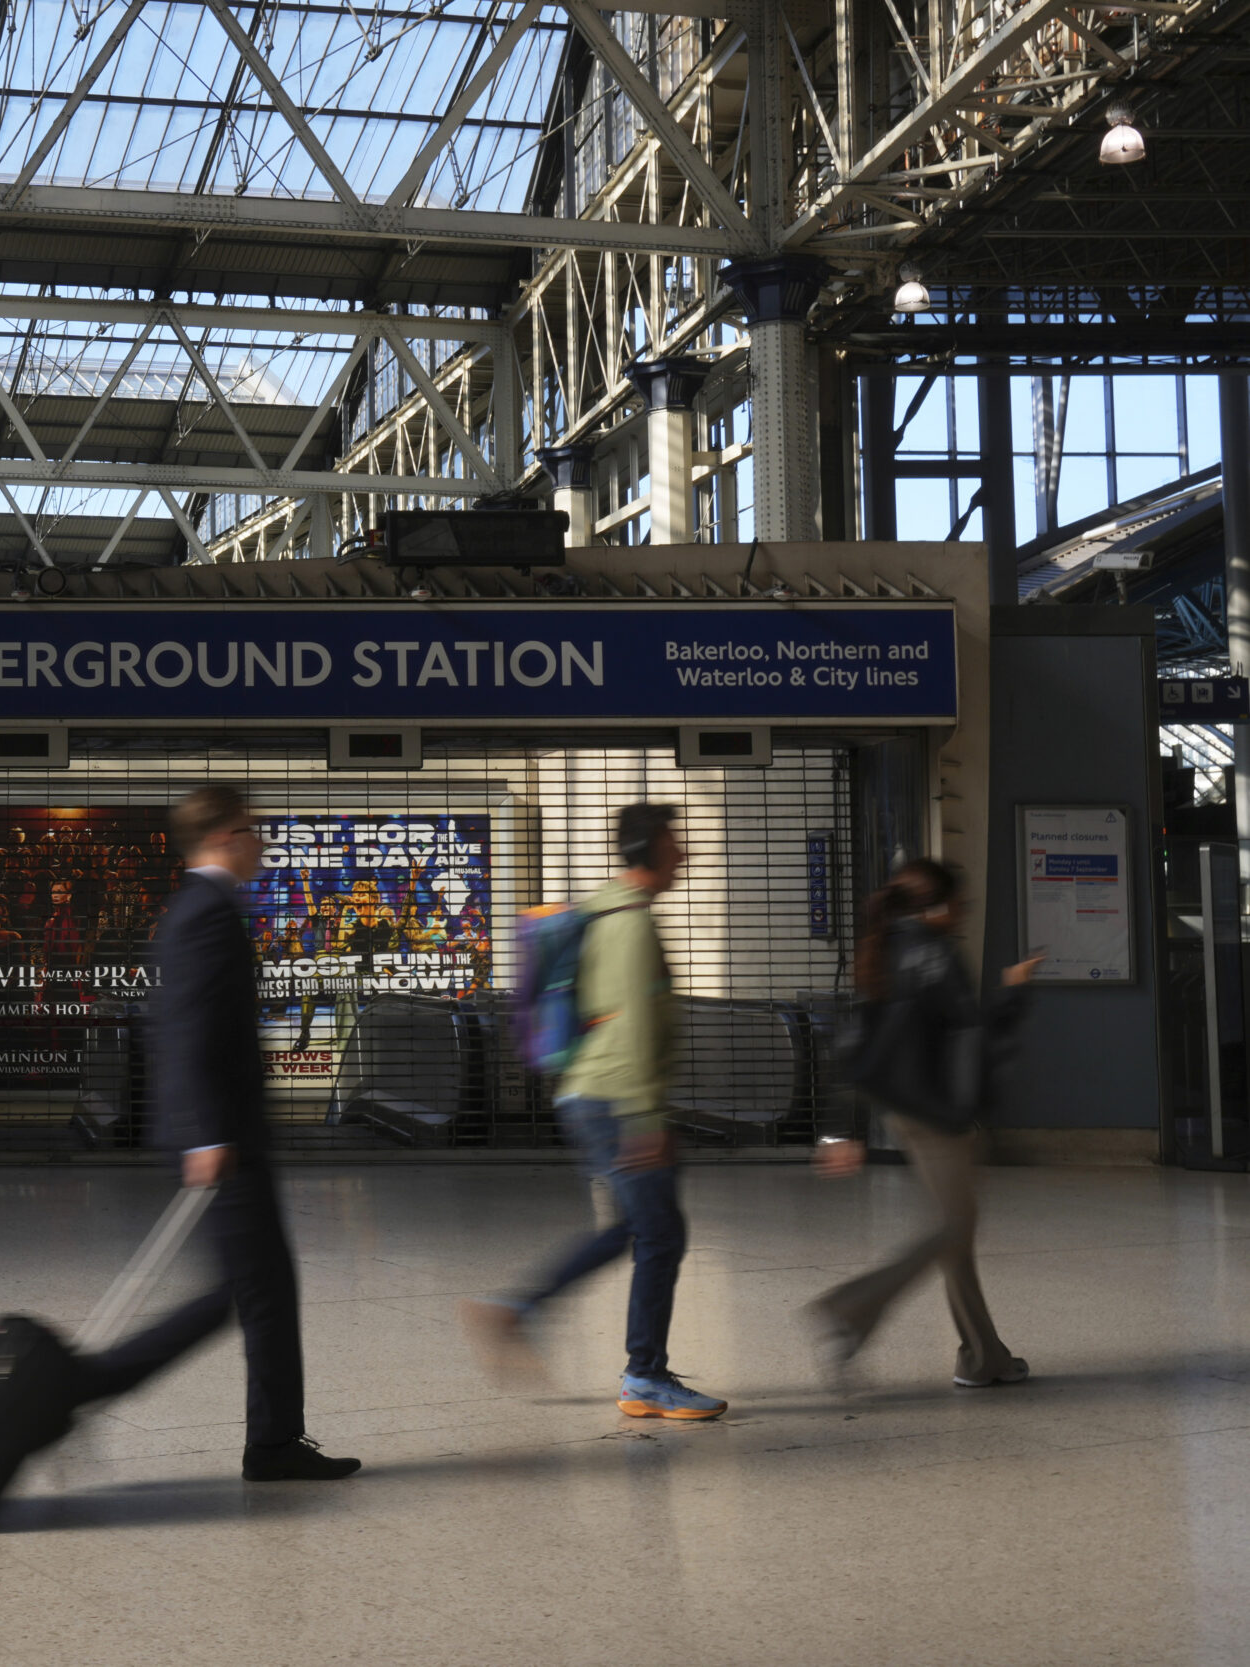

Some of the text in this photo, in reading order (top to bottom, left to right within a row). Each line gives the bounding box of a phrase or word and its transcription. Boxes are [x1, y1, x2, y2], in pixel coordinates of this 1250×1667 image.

[665, 641, 929, 662] Bakerloo, Northern and
[352, 641, 604, 688] STATION
[677, 667, 919, 690] Waterloo & City lines
[354, 824, 436, 843] FOR
[437, 833, 449, 843] THE
[1031, 832, 1109, 841] Planned closures
[437, 843, 482, 854] LIVE
[261, 847, 437, 868] ONE DAY
[434, 855, 469, 866] AID
[262, 954, 362, 978] MOST
[373, 953, 441, 972] FUN
[442, 953, 453, 966] IN
[455, 953, 472, 966] THE
[41, 970, 92, 982] WEARS
[121, 989, 146, 997] NEW
[256, 980, 290, 999] WEST
[294, 978, 319, 997] END
[55, 1004, 91, 1016] HOT
[262, 1051, 333, 1061] SHOWS
[263, 1063, 332, 1073] A WEEK
